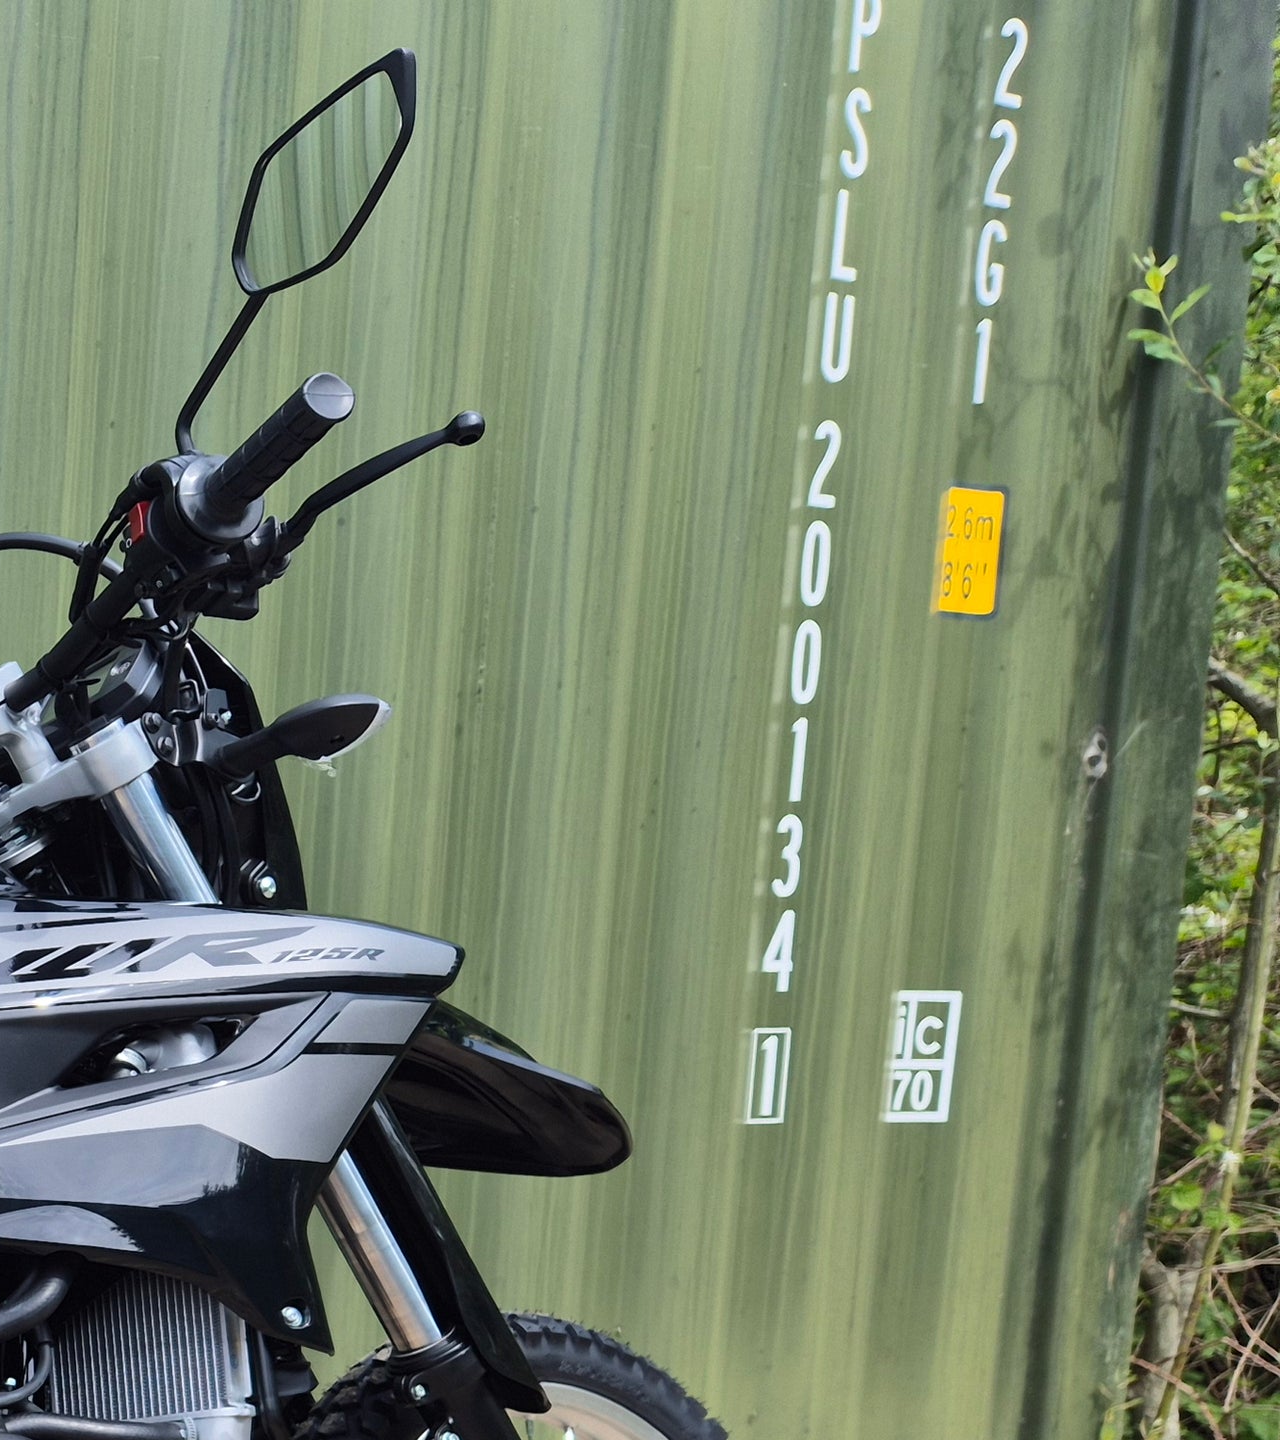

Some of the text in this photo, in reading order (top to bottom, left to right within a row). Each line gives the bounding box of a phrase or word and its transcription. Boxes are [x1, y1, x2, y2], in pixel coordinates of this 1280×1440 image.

[821, 0, 882, 384] PSLU
[972, 17, 1029, 405] 22G1
[761, 419, 843, 993] 200134
[269, 946, 386, 964] 125R
[891, 1069, 934, 1112] 70
